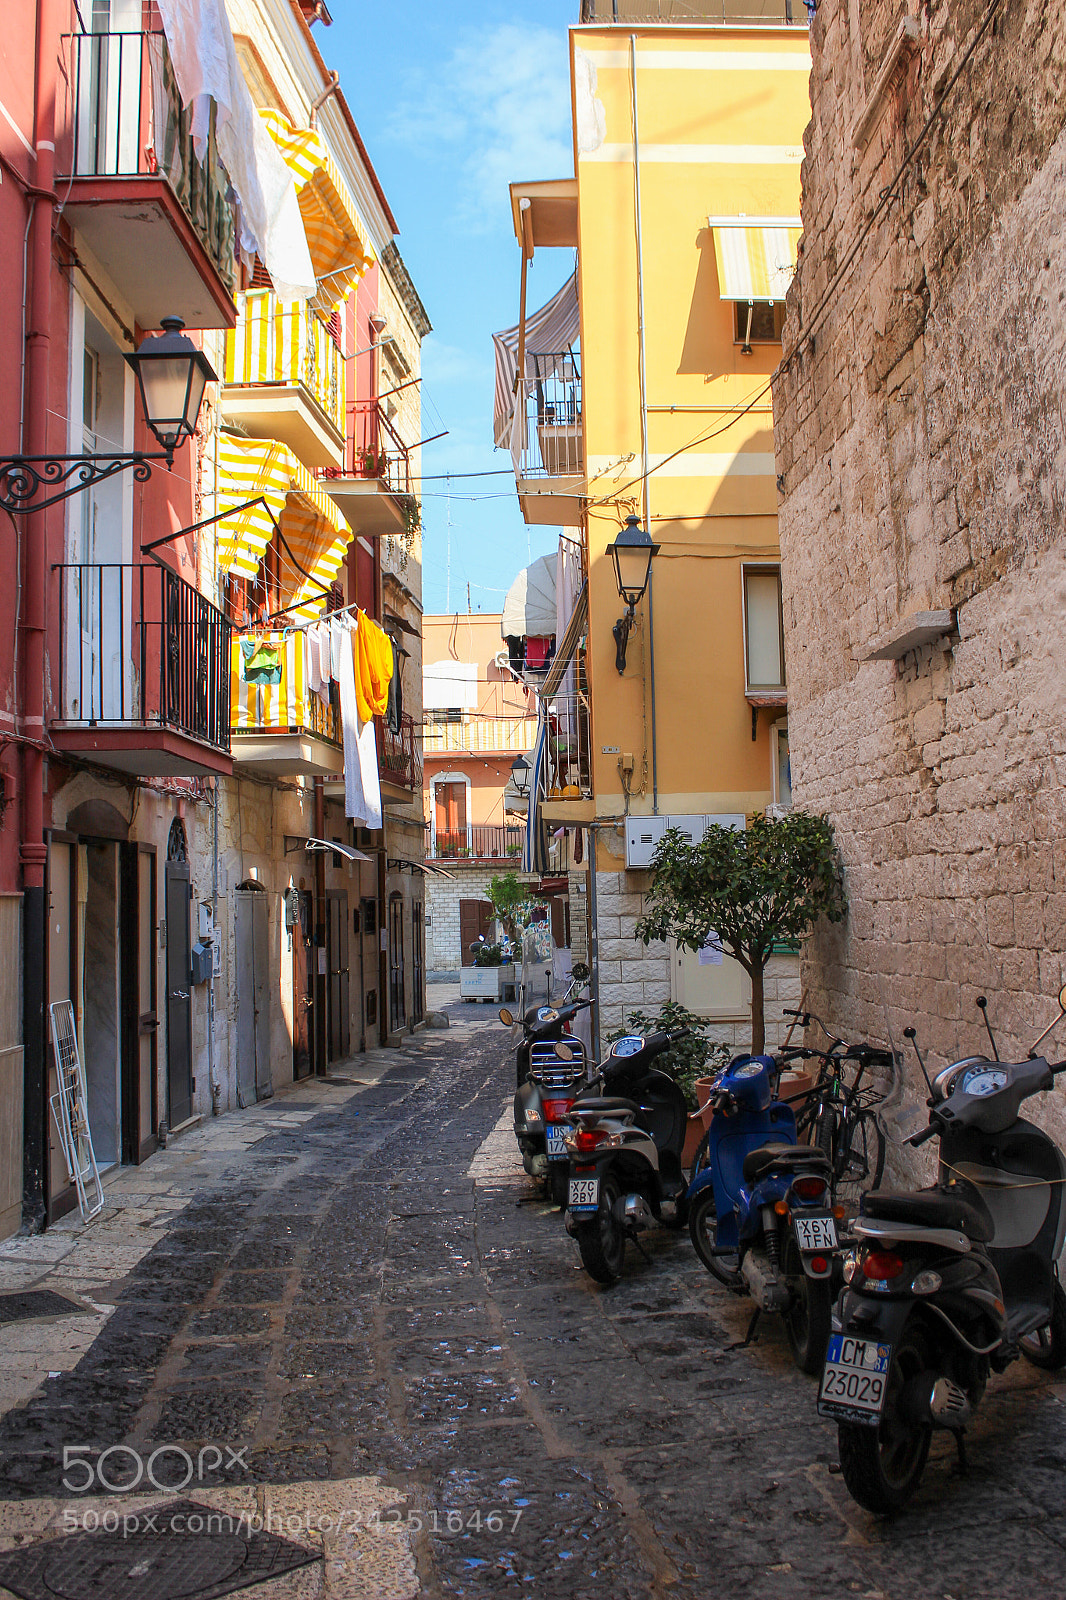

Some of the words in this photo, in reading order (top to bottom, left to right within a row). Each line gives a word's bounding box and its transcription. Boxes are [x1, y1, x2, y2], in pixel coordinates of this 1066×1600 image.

[553, 1126, 565, 1138] DS
[572, 1181, 595, 1193] X7C
[572, 1192, 595, 1203] 2BY
[801, 1220, 829, 1234] X6Y
[803, 1234, 833, 1248] TFN
[841, 1339, 867, 1367] CM
[824, 1369, 883, 1403] 23029
